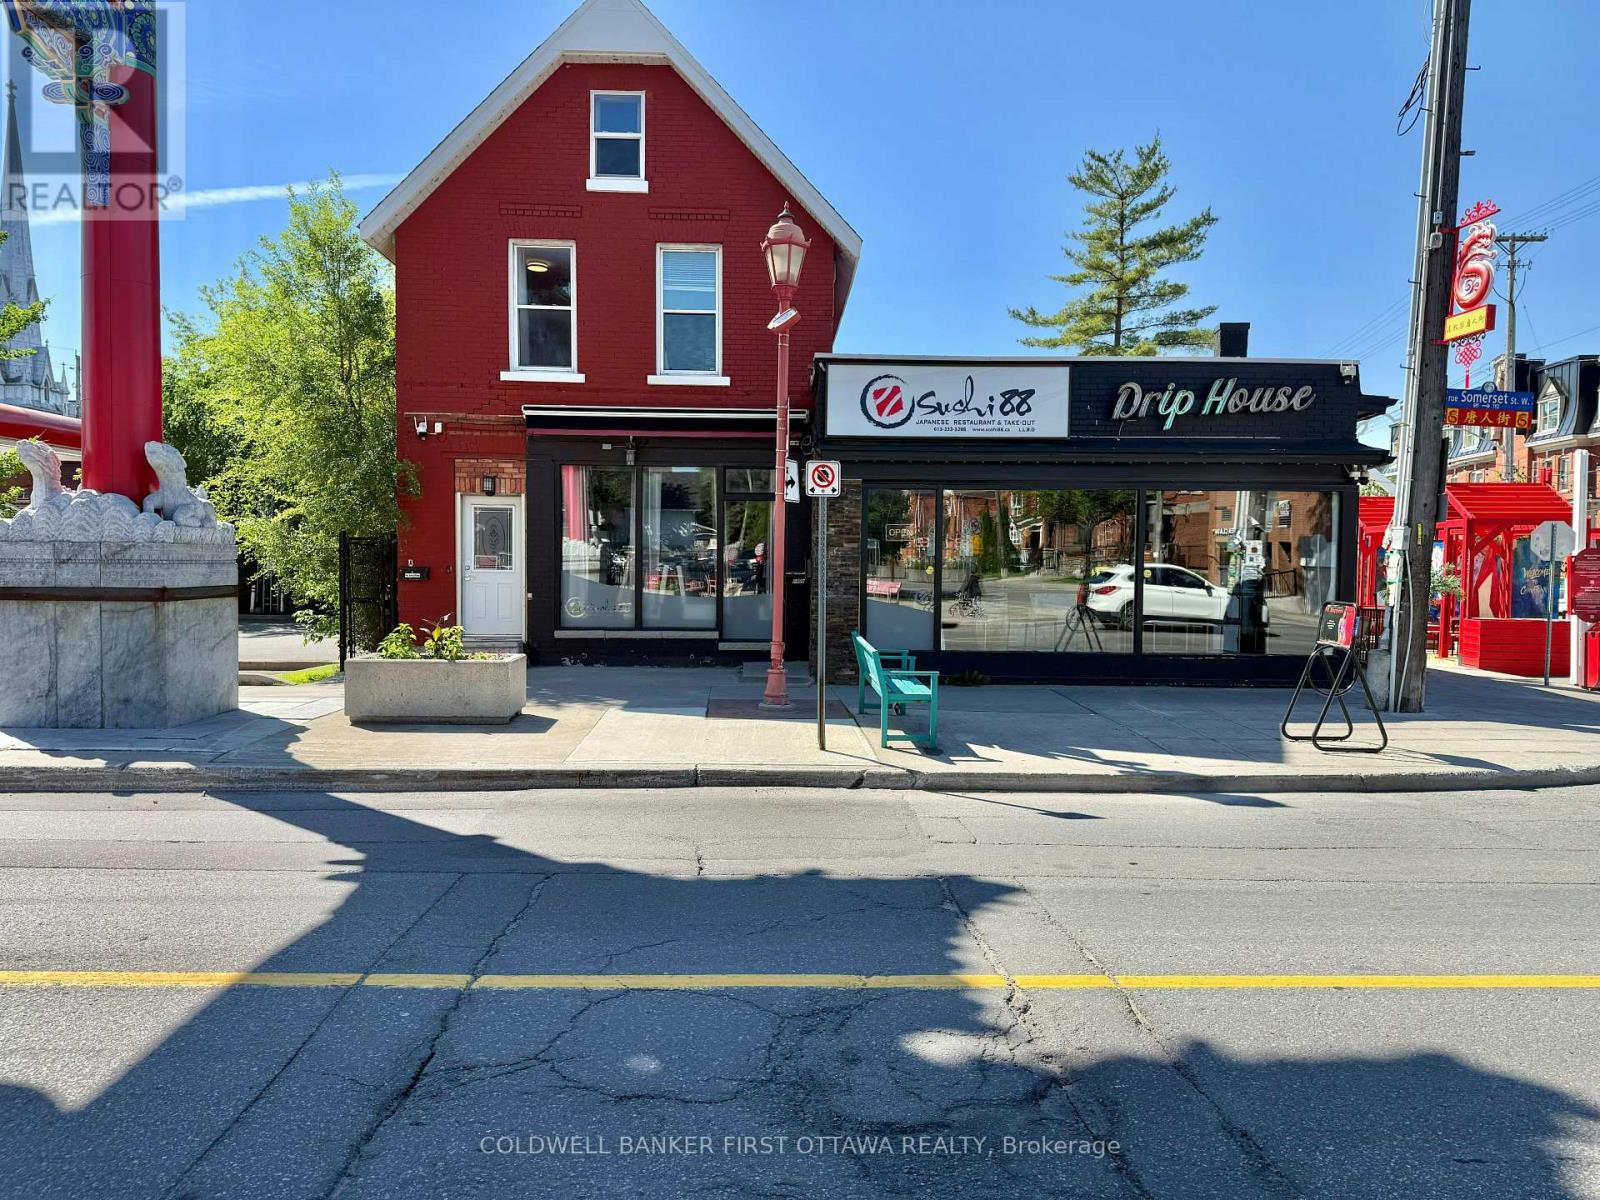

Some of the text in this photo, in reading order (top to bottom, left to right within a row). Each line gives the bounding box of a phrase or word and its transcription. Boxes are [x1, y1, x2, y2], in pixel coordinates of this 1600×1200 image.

[1111, 377, 1316, 431] Drip House
[1461, 390, 1508, 404] Somerset
[1510, 397, 1519, 405] St.
[1463, 410, 1511, 426] 唐人街
[888, 528, 915, 538] OPEN
